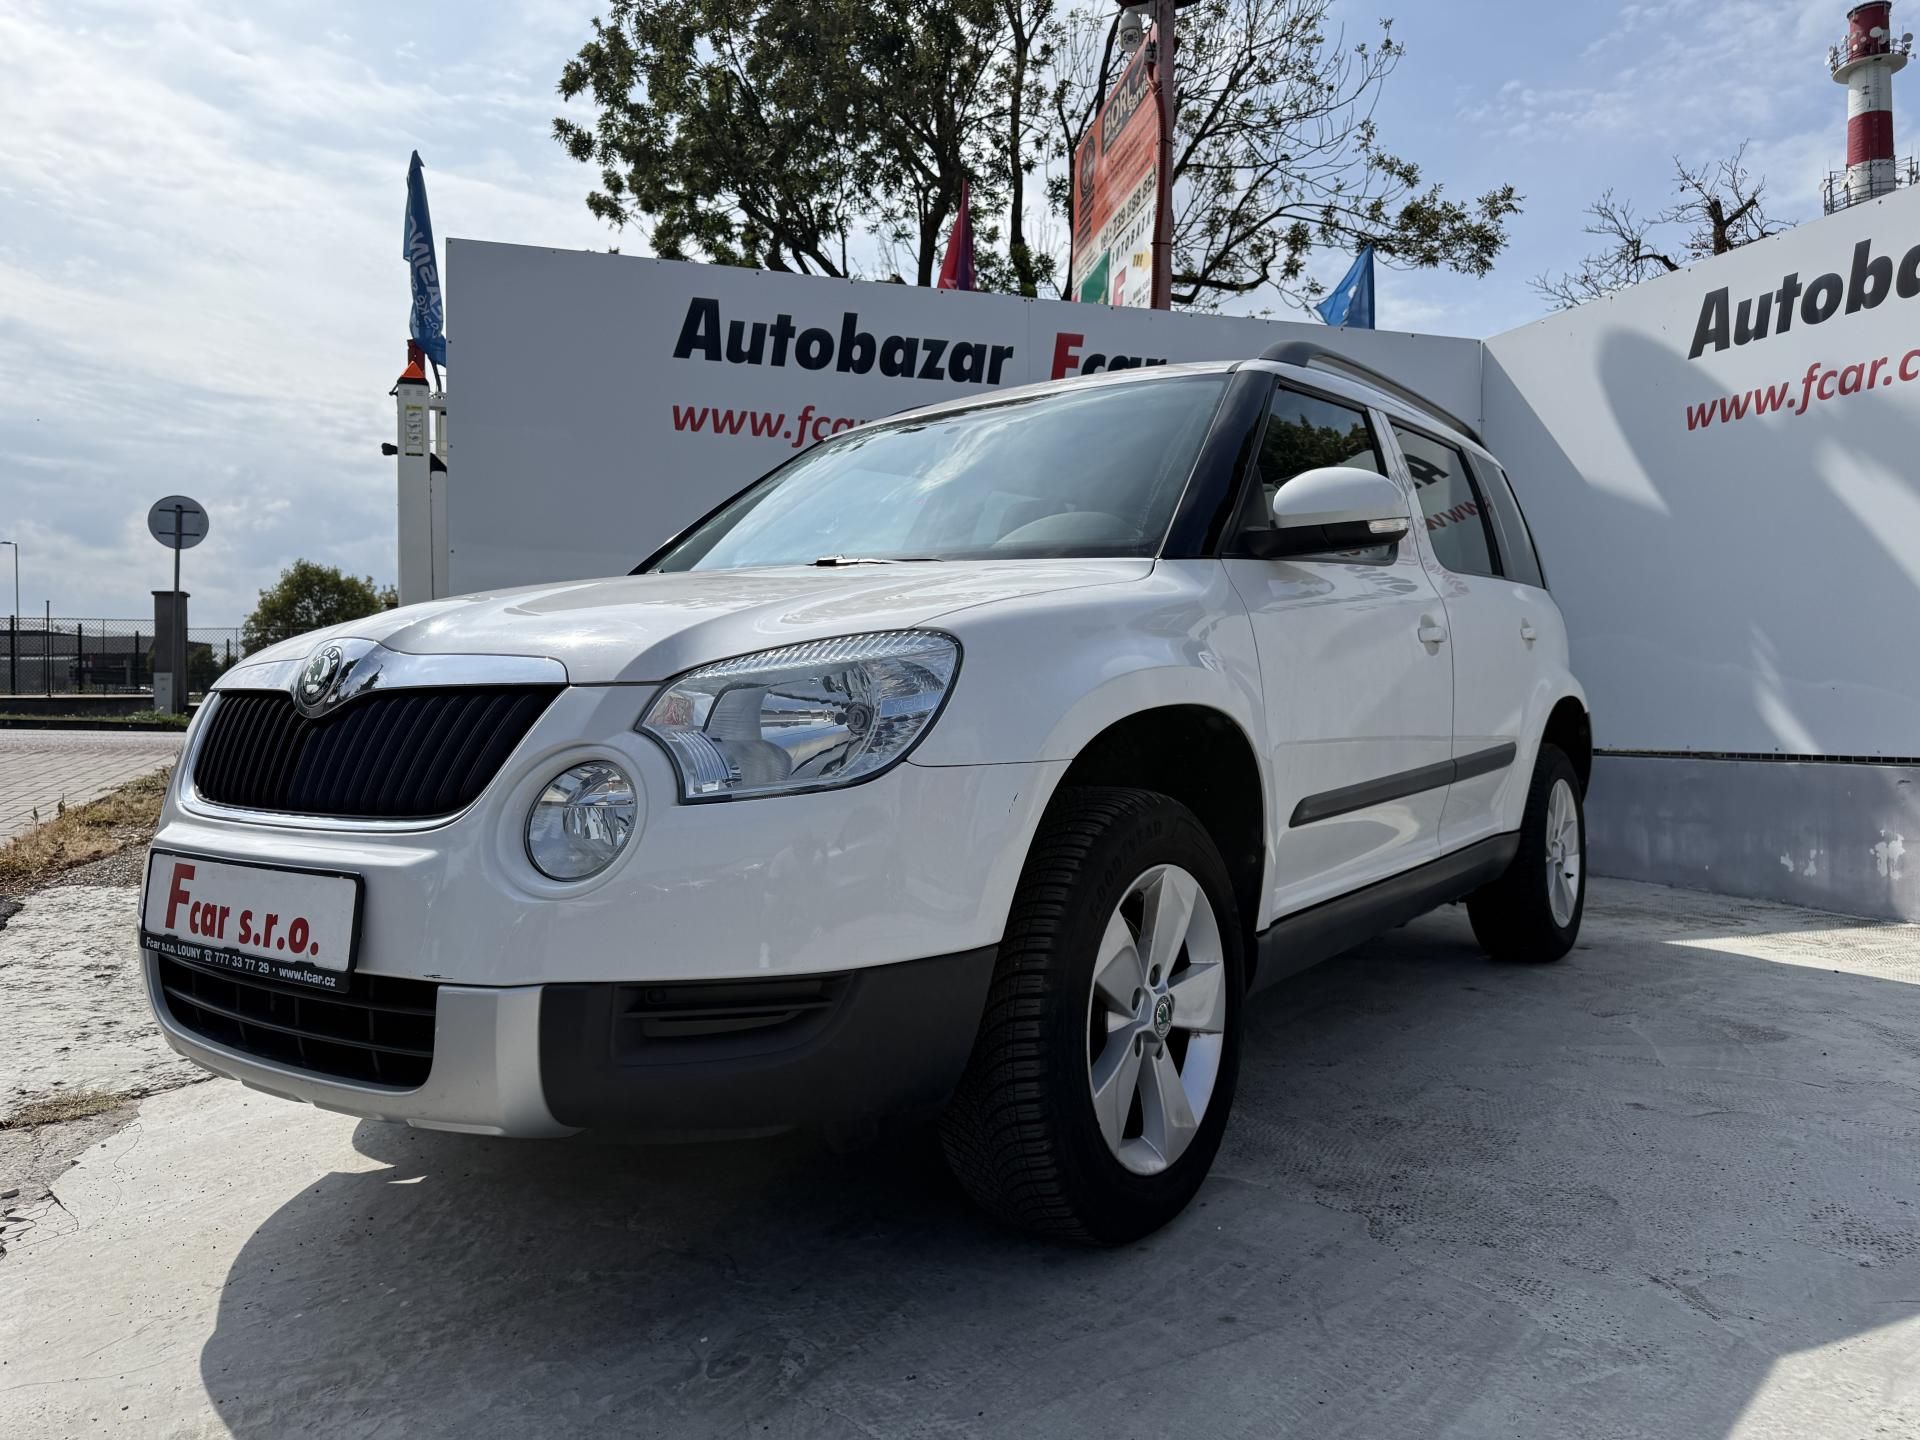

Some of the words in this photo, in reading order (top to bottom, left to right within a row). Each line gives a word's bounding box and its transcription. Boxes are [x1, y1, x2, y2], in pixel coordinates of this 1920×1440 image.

[672, 297, 1014, 386] Autobazar
[165, 863, 230, 940] Fcar
[238, 909, 319, 956] s.r.o.
[146, 937, 161, 950] Fcar
[177, 944, 201, 959] LOUNY
[214, 951, 230, 965] 777
[232, 955, 243, 968] 33
[244, 958, 256, 971] 77
[258, 961, 270, 974] 29
[279, 967, 337, 987] www.fcar.cz
